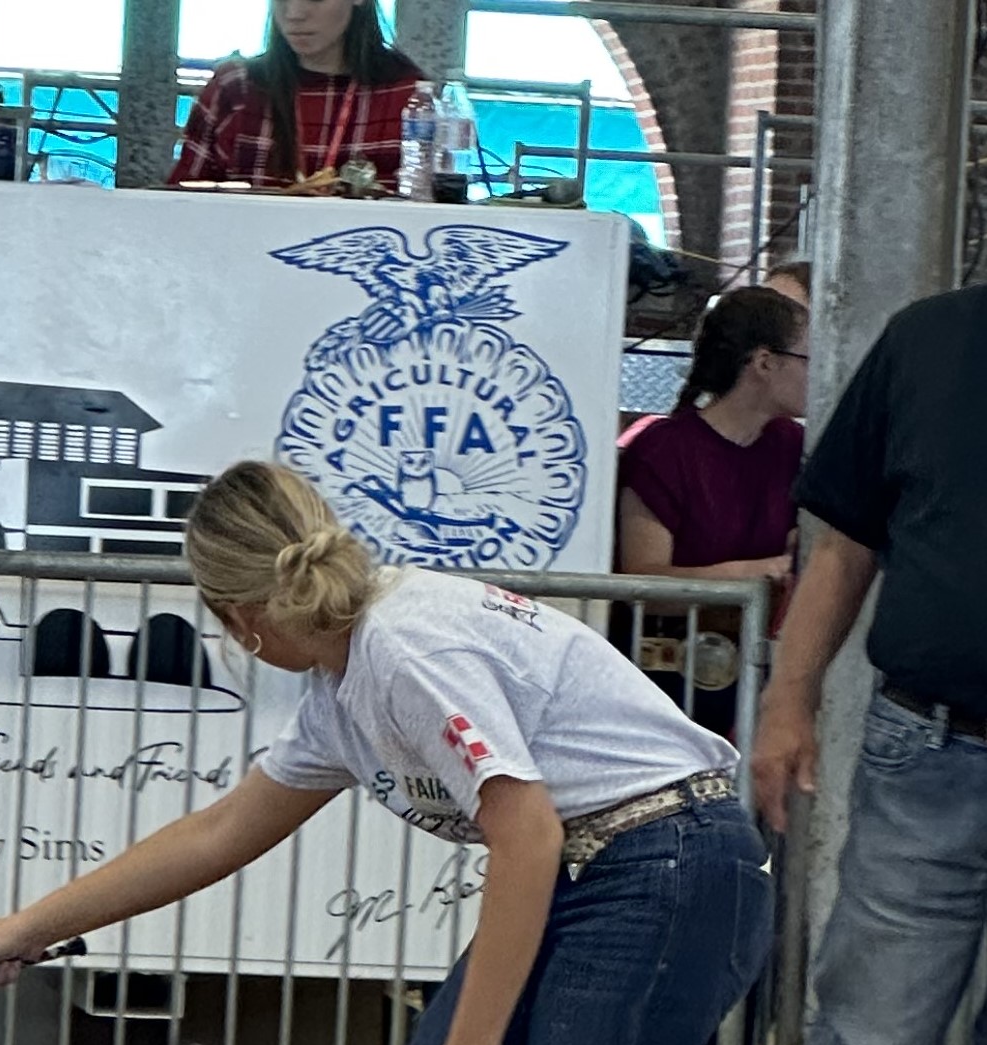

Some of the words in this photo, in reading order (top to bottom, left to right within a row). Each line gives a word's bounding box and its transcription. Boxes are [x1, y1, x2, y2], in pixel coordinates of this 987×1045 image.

[325, 364, 538, 472] AGRICULTURAL
[379, 405, 495, 455] FFA
[68, 755, 133, 789] and
[134, 742, 232, 792] Friends
[18, 825, 105, 862] Sims
